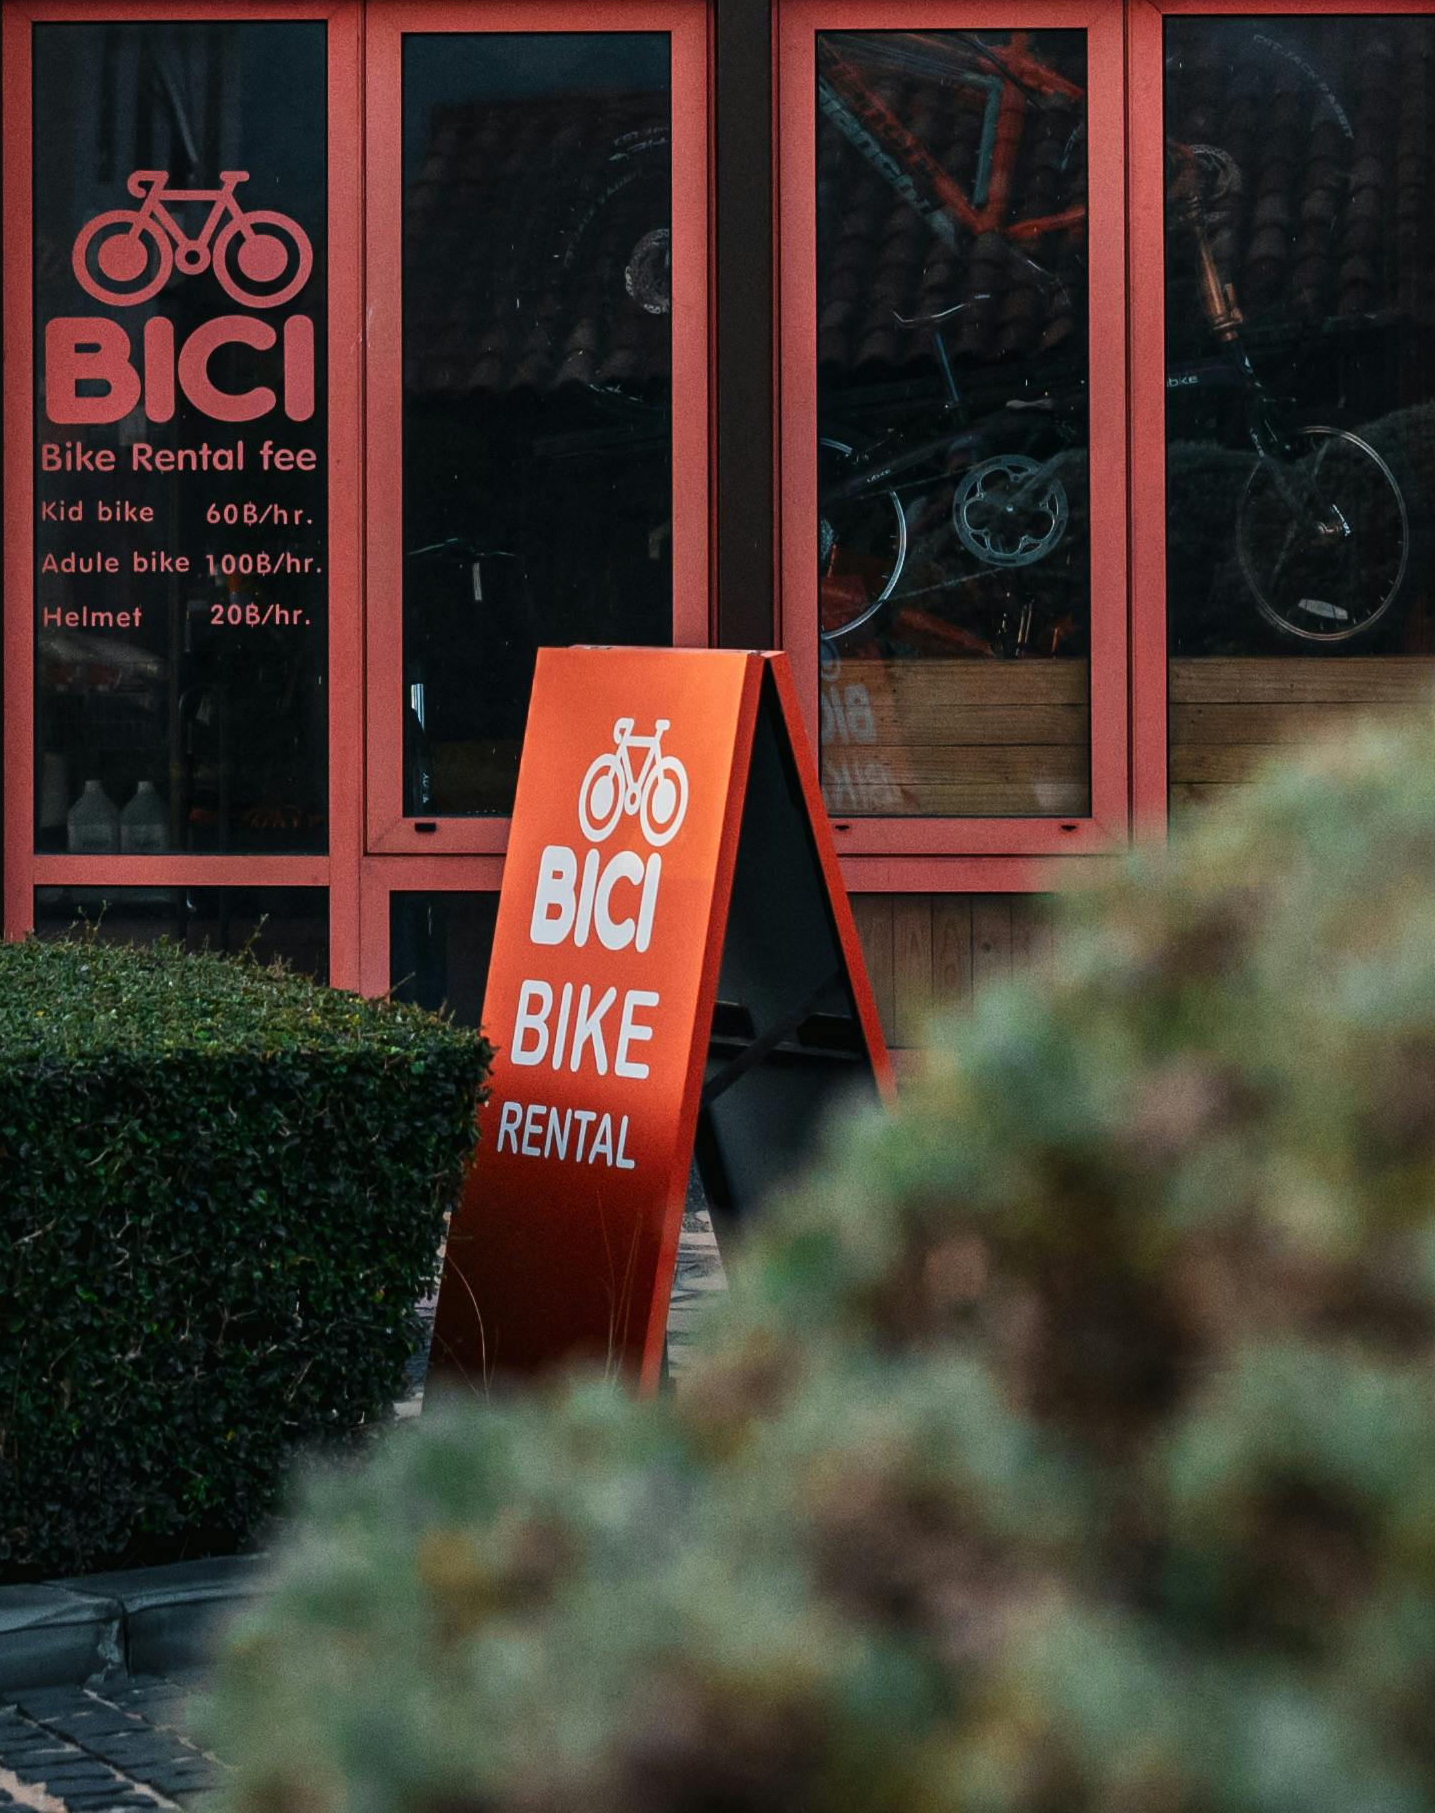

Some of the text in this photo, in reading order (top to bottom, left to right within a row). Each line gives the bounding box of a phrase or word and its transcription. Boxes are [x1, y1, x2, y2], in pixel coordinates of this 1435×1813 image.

[45, 314, 316, 425] BICI
[41, 440, 318, 472] Bike Rental fee
[40, 500, 83, 522] Kid
[98, 500, 155, 523] bike
[41, 551, 120, 574] Adule
[132, 551, 191, 574] bike
[42, 606, 143, 629] Helmet
[529, 844, 662, 953] BICI
[510, 978, 660, 1080] BIKE
[496, 1101, 636, 1170] RENTAL
